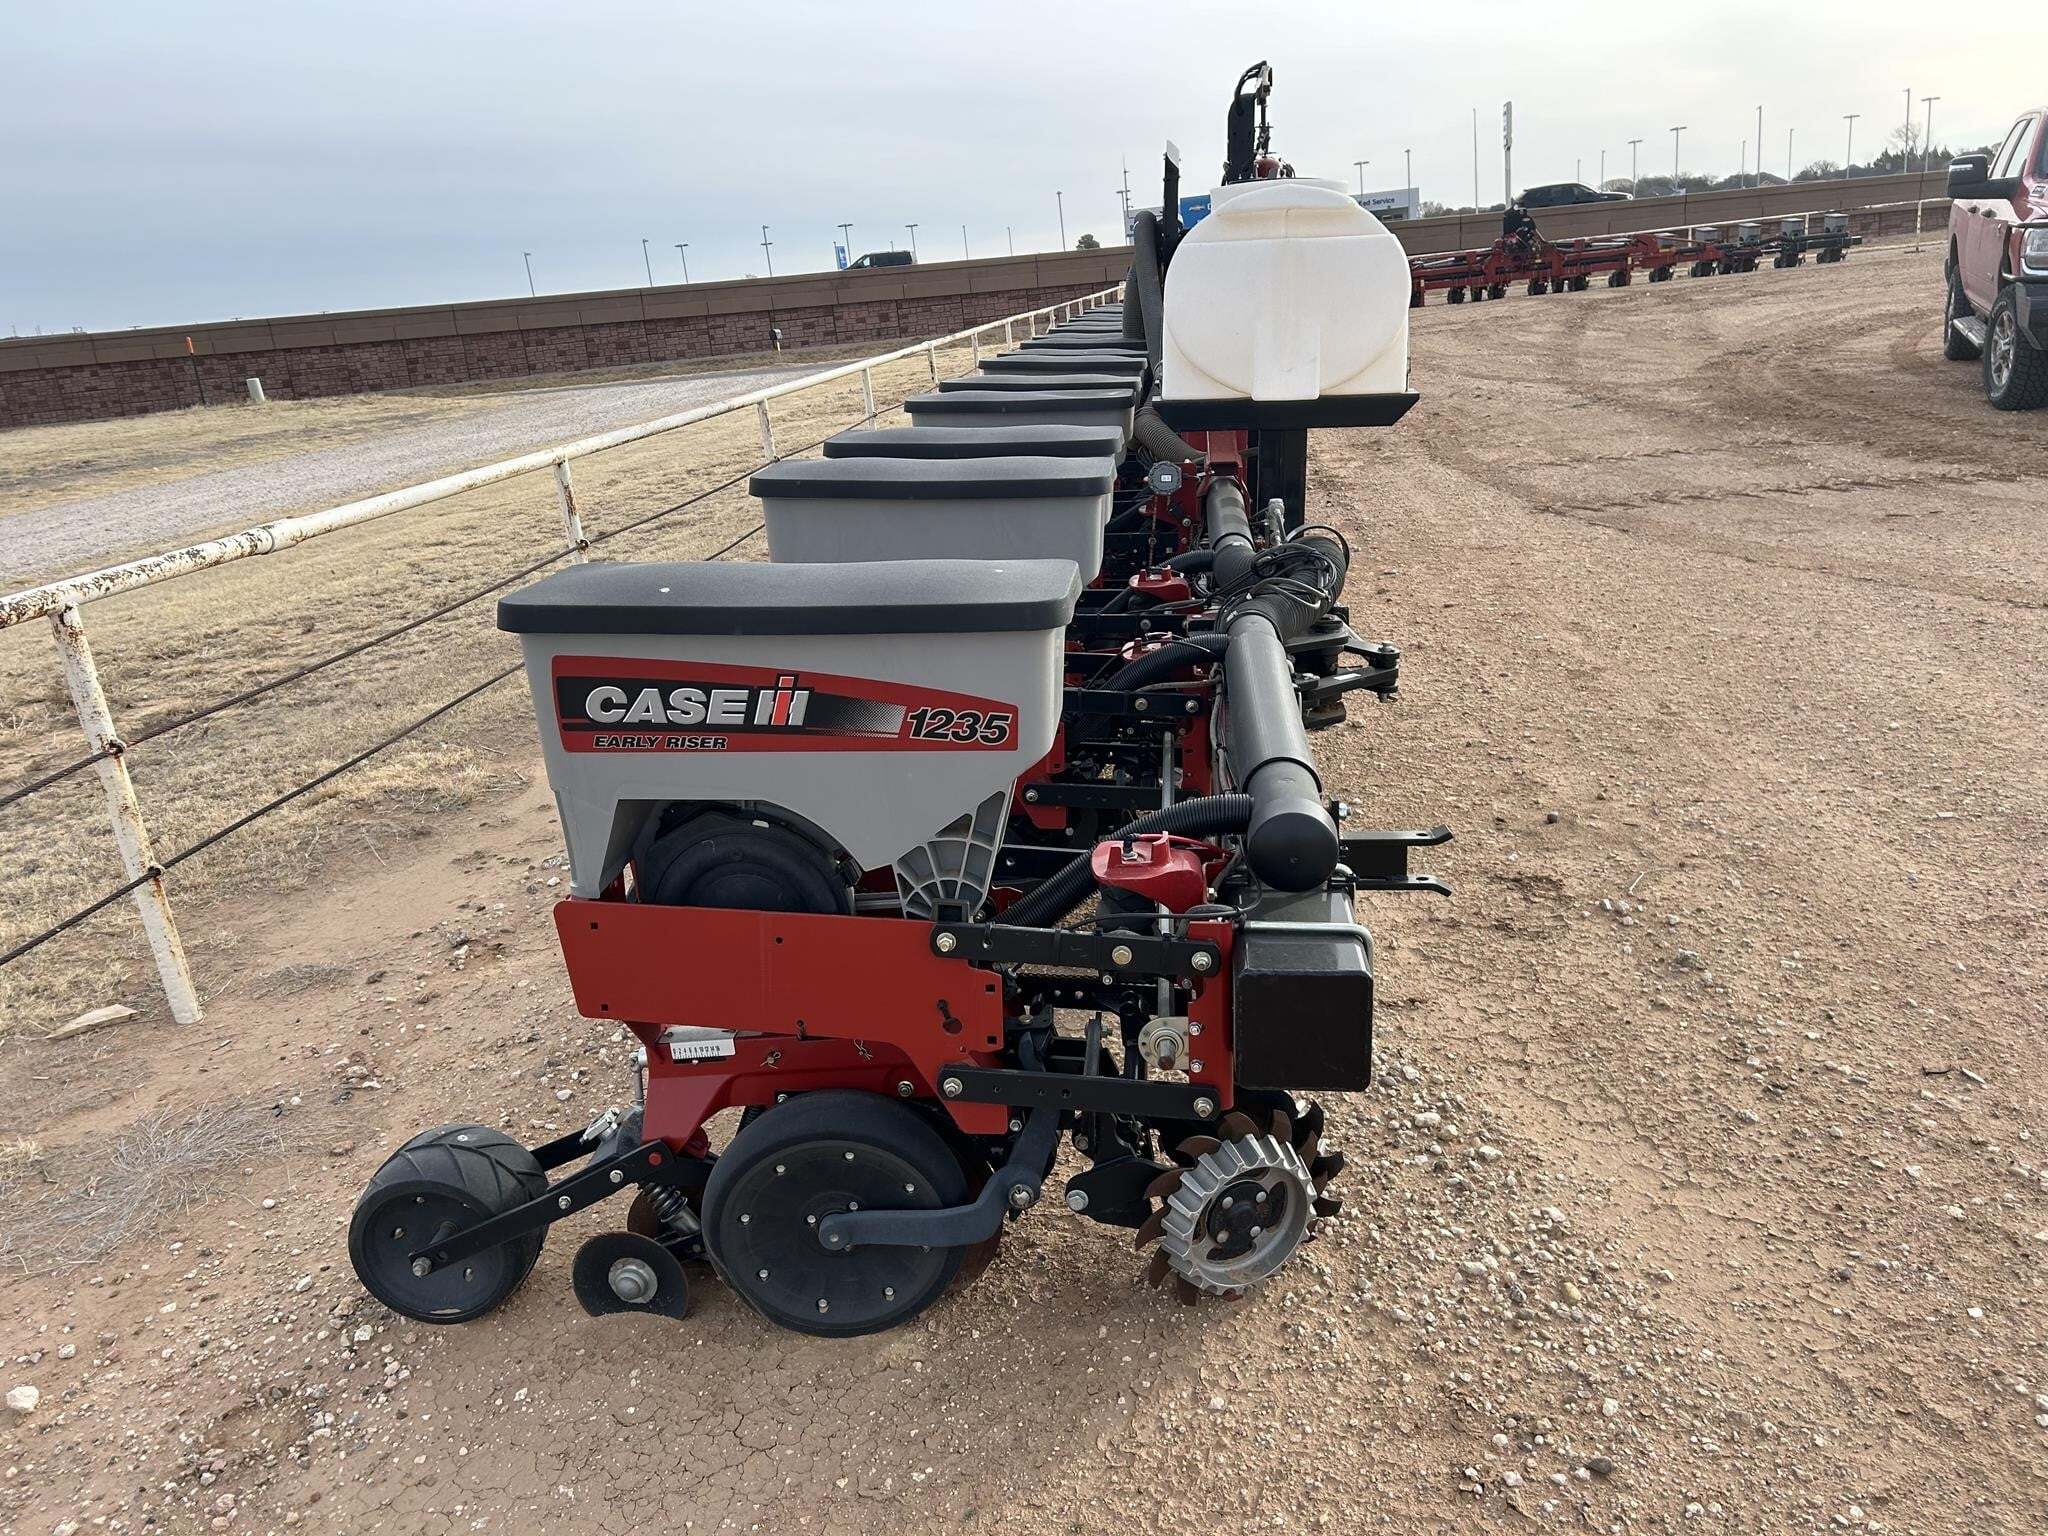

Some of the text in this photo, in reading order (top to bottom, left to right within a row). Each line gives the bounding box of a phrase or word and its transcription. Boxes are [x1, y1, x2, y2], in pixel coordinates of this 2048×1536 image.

[1372, 197, 1395, 205] Service
[585, 685, 750, 725] CASE
[907, 706, 1013, 745] 1235
[593, 735, 728, 749] EARLY RISER
